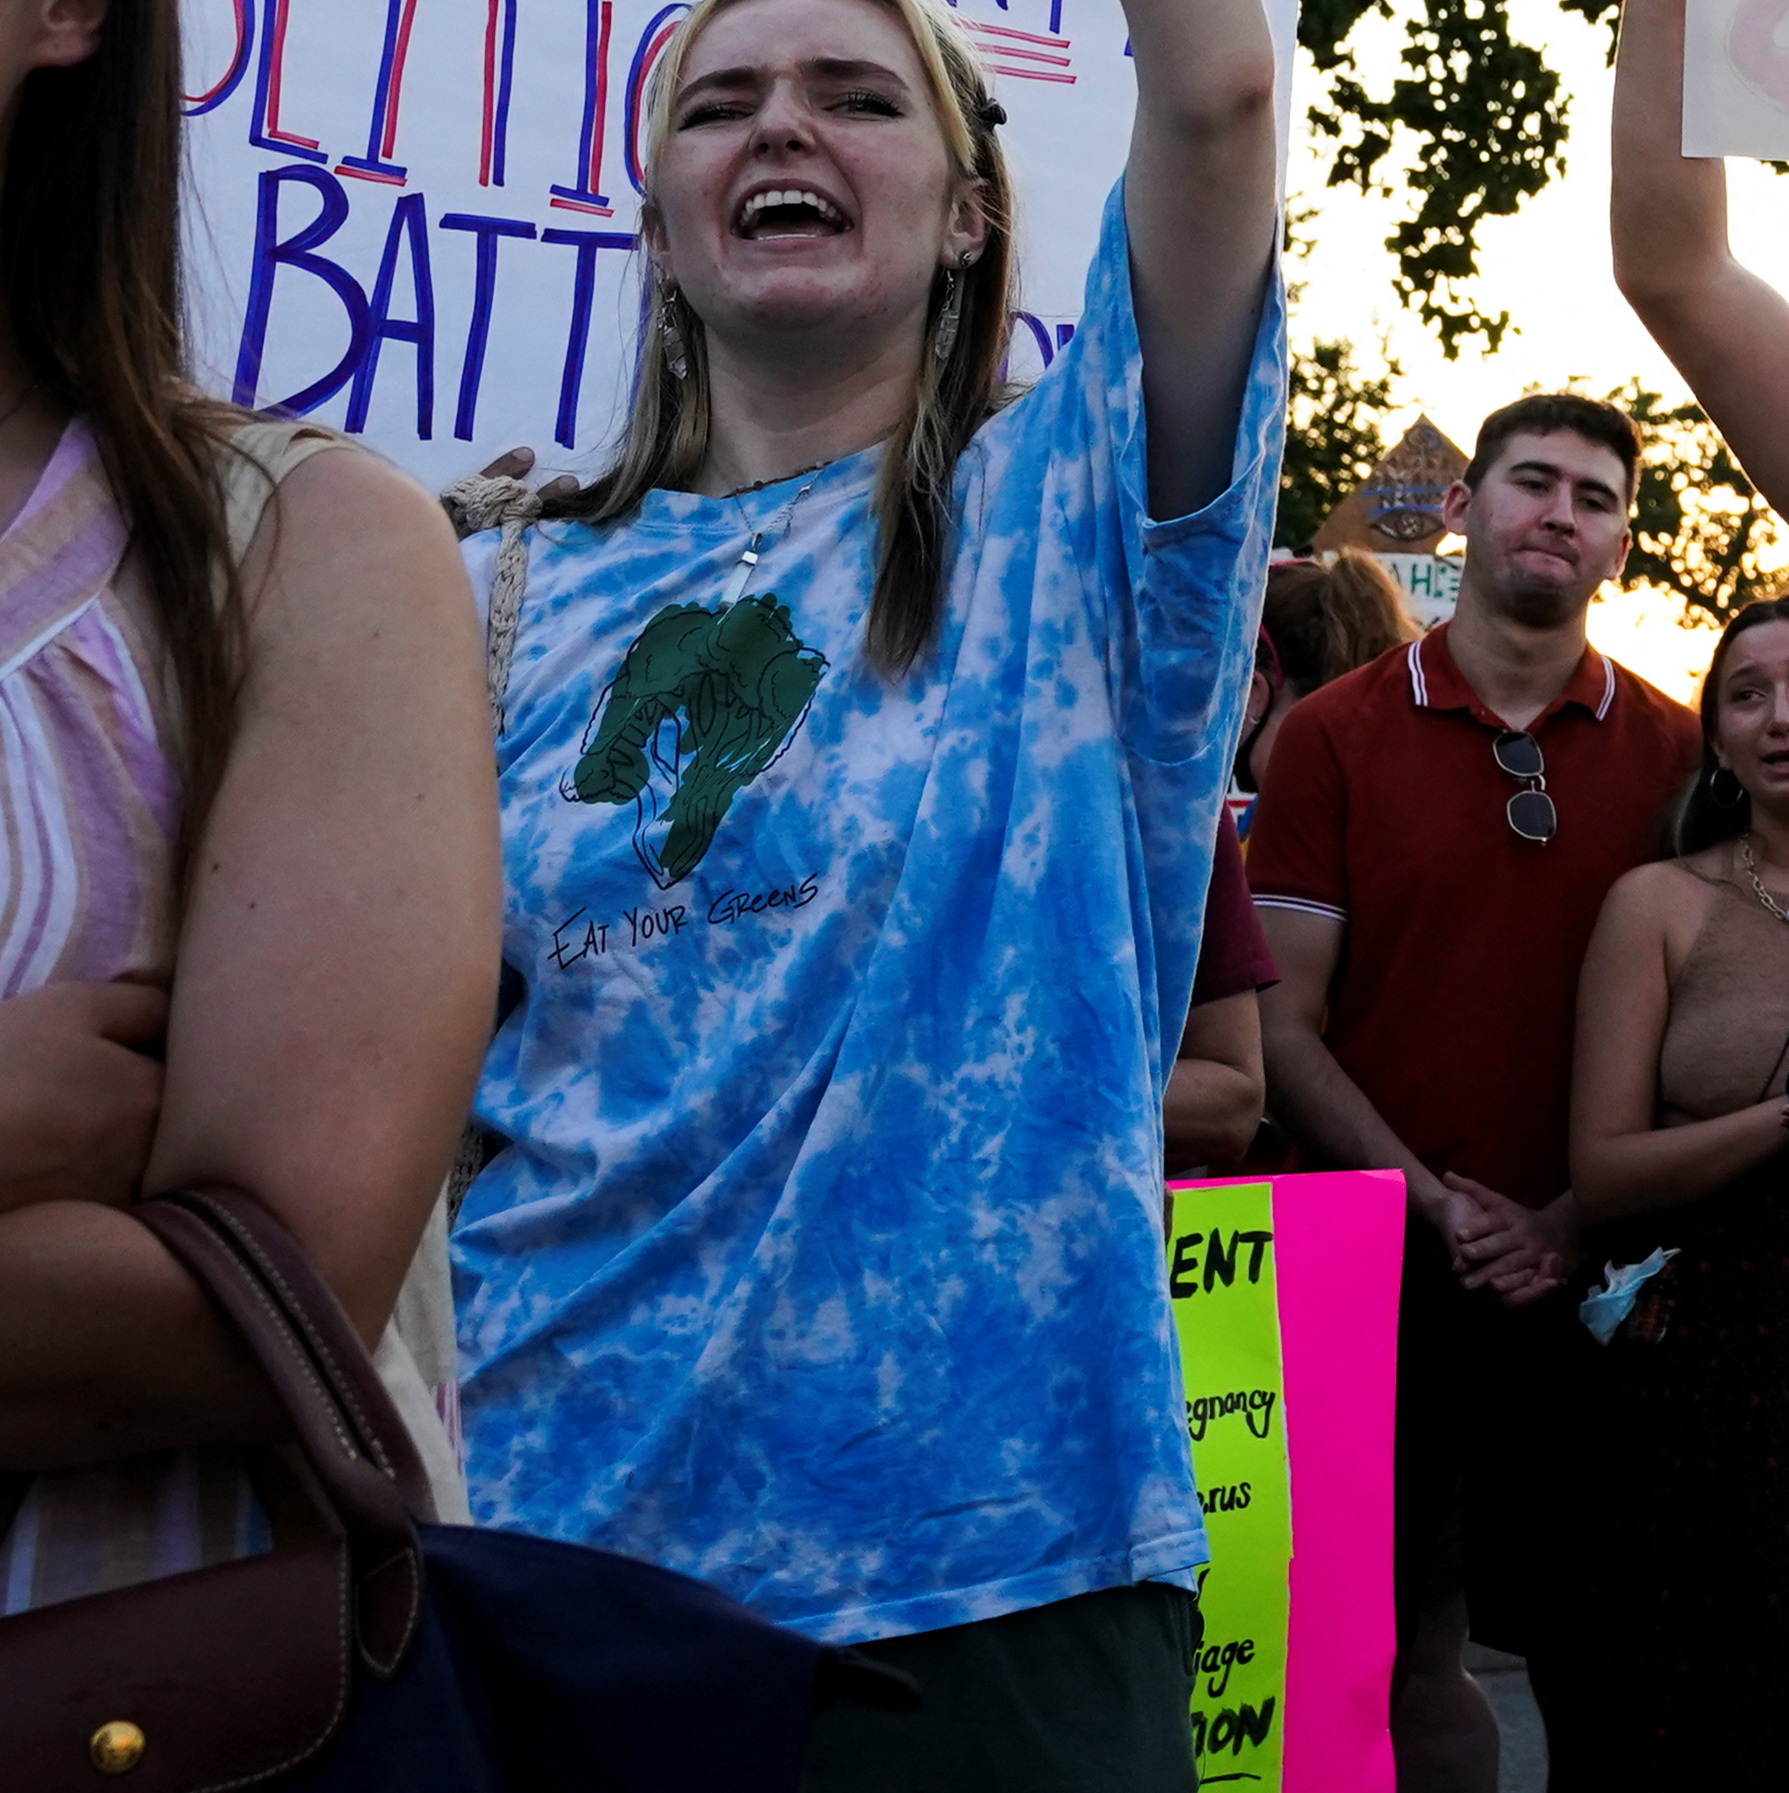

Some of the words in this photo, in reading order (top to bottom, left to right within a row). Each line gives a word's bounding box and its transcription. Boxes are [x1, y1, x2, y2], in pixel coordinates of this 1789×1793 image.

[548, 908, 609, 970] EAT
[624, 906, 688, 946] YOUR
[1170, 1228, 1273, 1299] ENT
